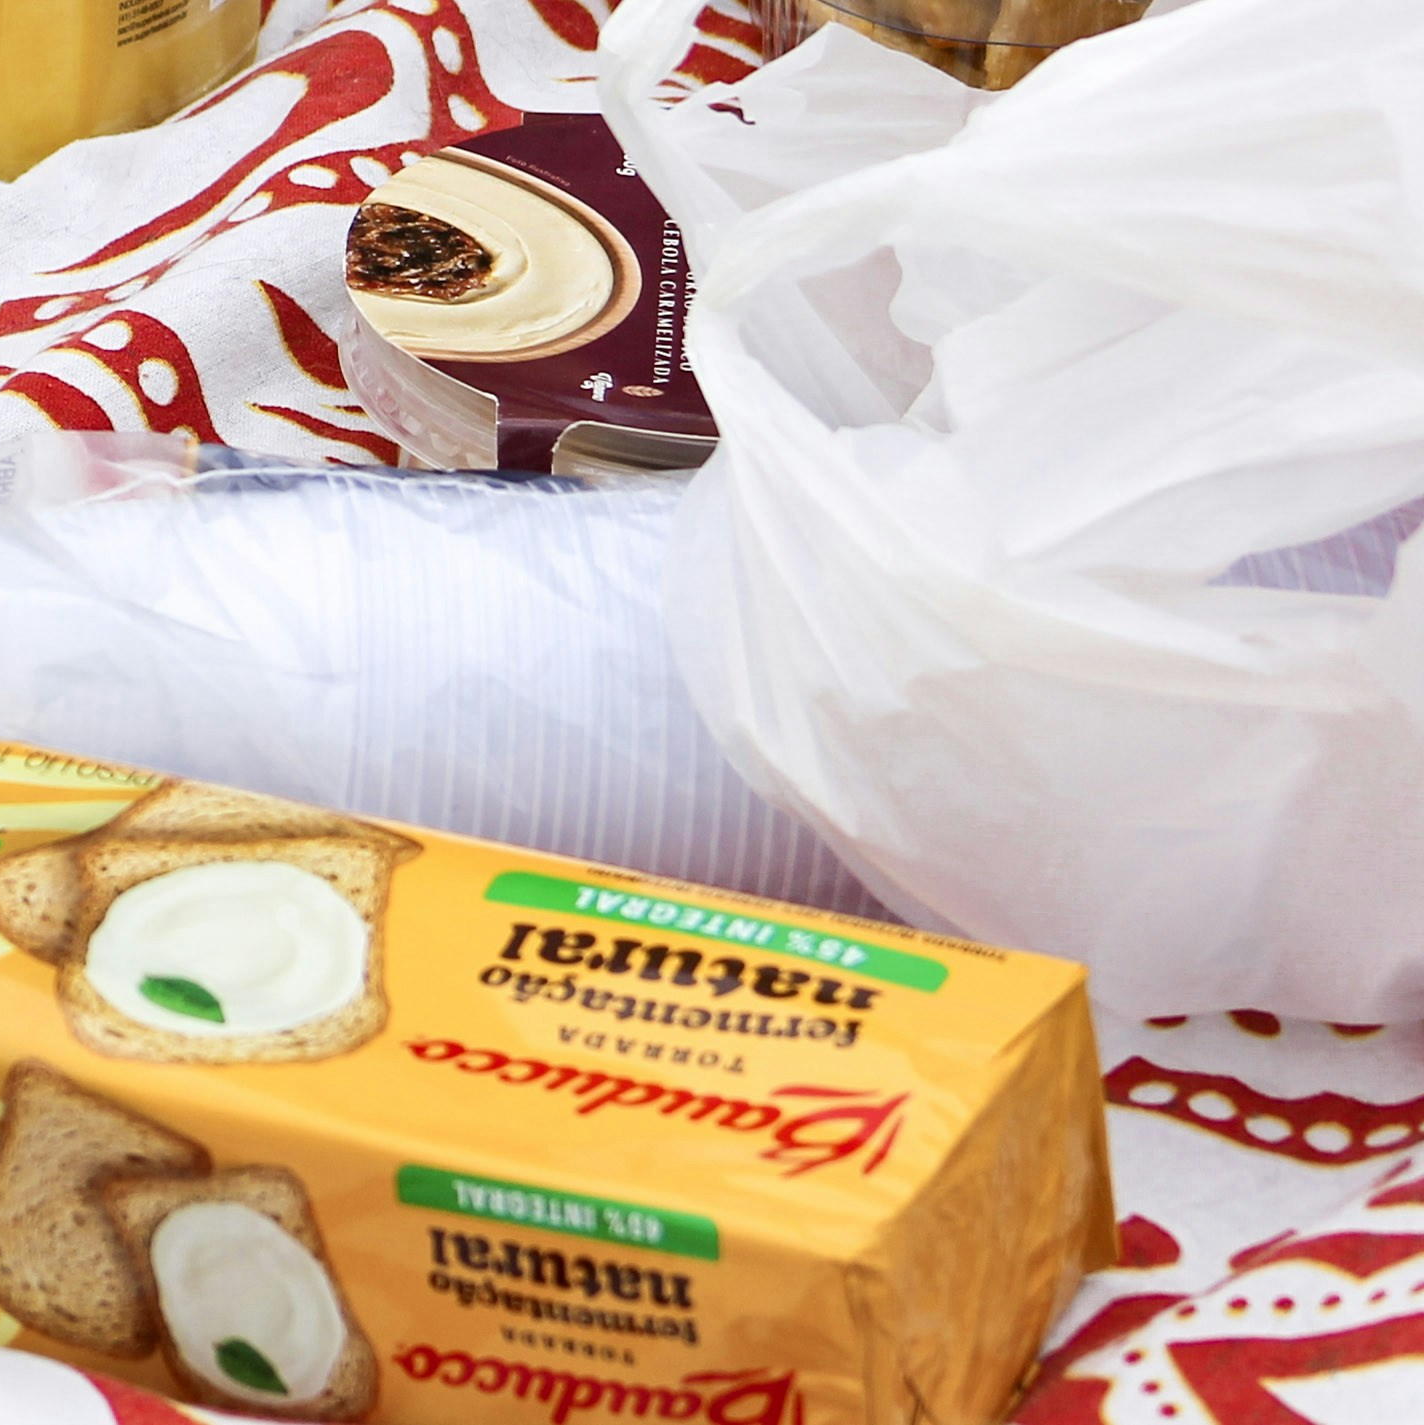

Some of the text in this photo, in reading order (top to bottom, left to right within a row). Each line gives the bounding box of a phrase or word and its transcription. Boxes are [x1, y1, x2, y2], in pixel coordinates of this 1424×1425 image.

[653, 219, 681, 383] CEBOLA CARAMELIZADA
[574, 886, 775, 947] INTEGRAL
[785, 932, 869, 969] 45%
[479, 964, 861, 1048] fermentação
[498, 922, 884, 1013] natural
[557, 1024, 747, 1075] TORRADA
[404, 1039, 911, 1177] Bauducco
[453, 1177, 597, 1231] INTEGRAL
[428, 1226, 695, 1311] natural
[428, 1269, 701, 1346] fermentação
[393, 1342, 807, 1425] Bauducco
[500, 1325, 636, 1366] TORRADA
